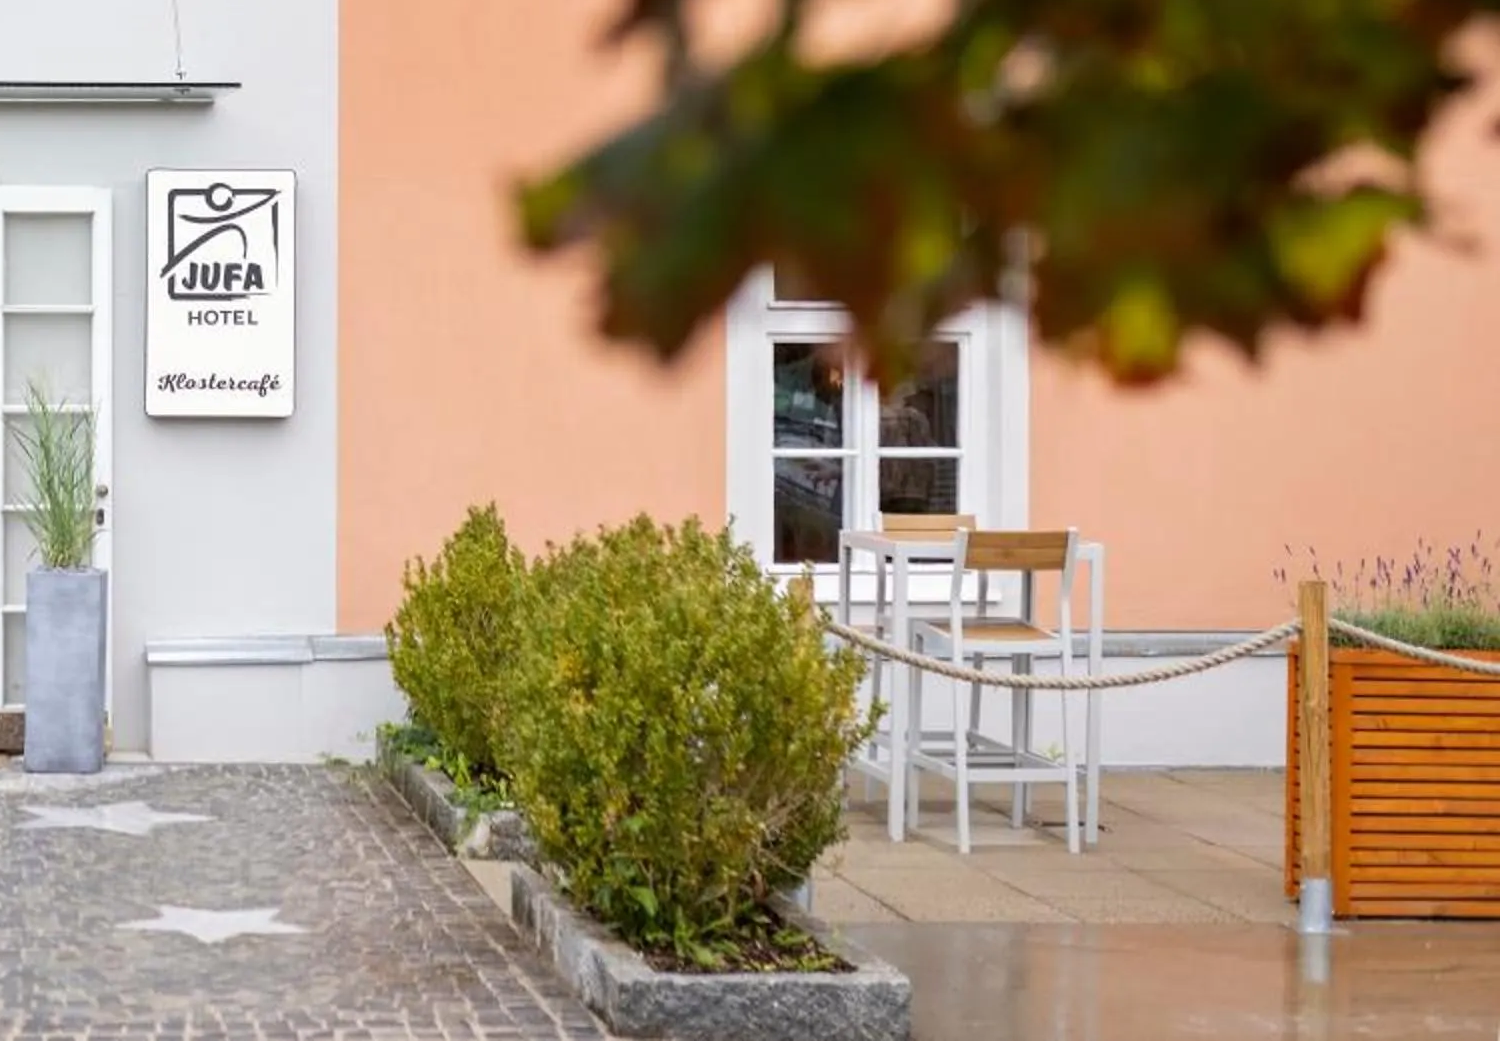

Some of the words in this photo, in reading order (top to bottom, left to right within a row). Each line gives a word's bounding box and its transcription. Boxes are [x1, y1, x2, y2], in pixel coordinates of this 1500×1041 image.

[182, 261, 264, 291] JUFA
[188, 310, 258, 326] HOTEL
[157, 373, 281, 398] Klostercafé
